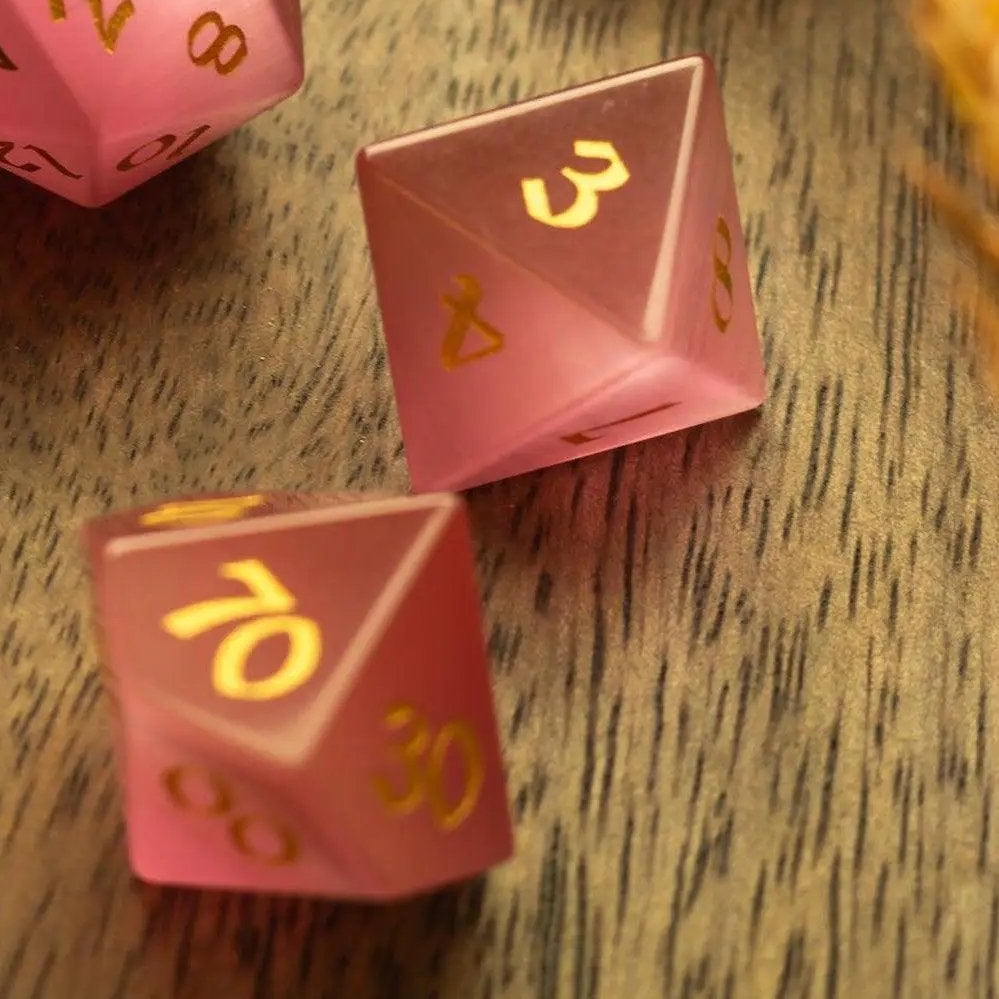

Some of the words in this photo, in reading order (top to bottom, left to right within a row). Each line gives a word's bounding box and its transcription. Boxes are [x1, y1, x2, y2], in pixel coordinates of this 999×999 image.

[187, 10, 248, 76] 8
[116, 124, 211, 172] 10
[521, 139, 630, 228] 3
[711, 216, 733, 334] 8
[441, 273, 505, 372] 4
[371, 706, 485, 831] 30
